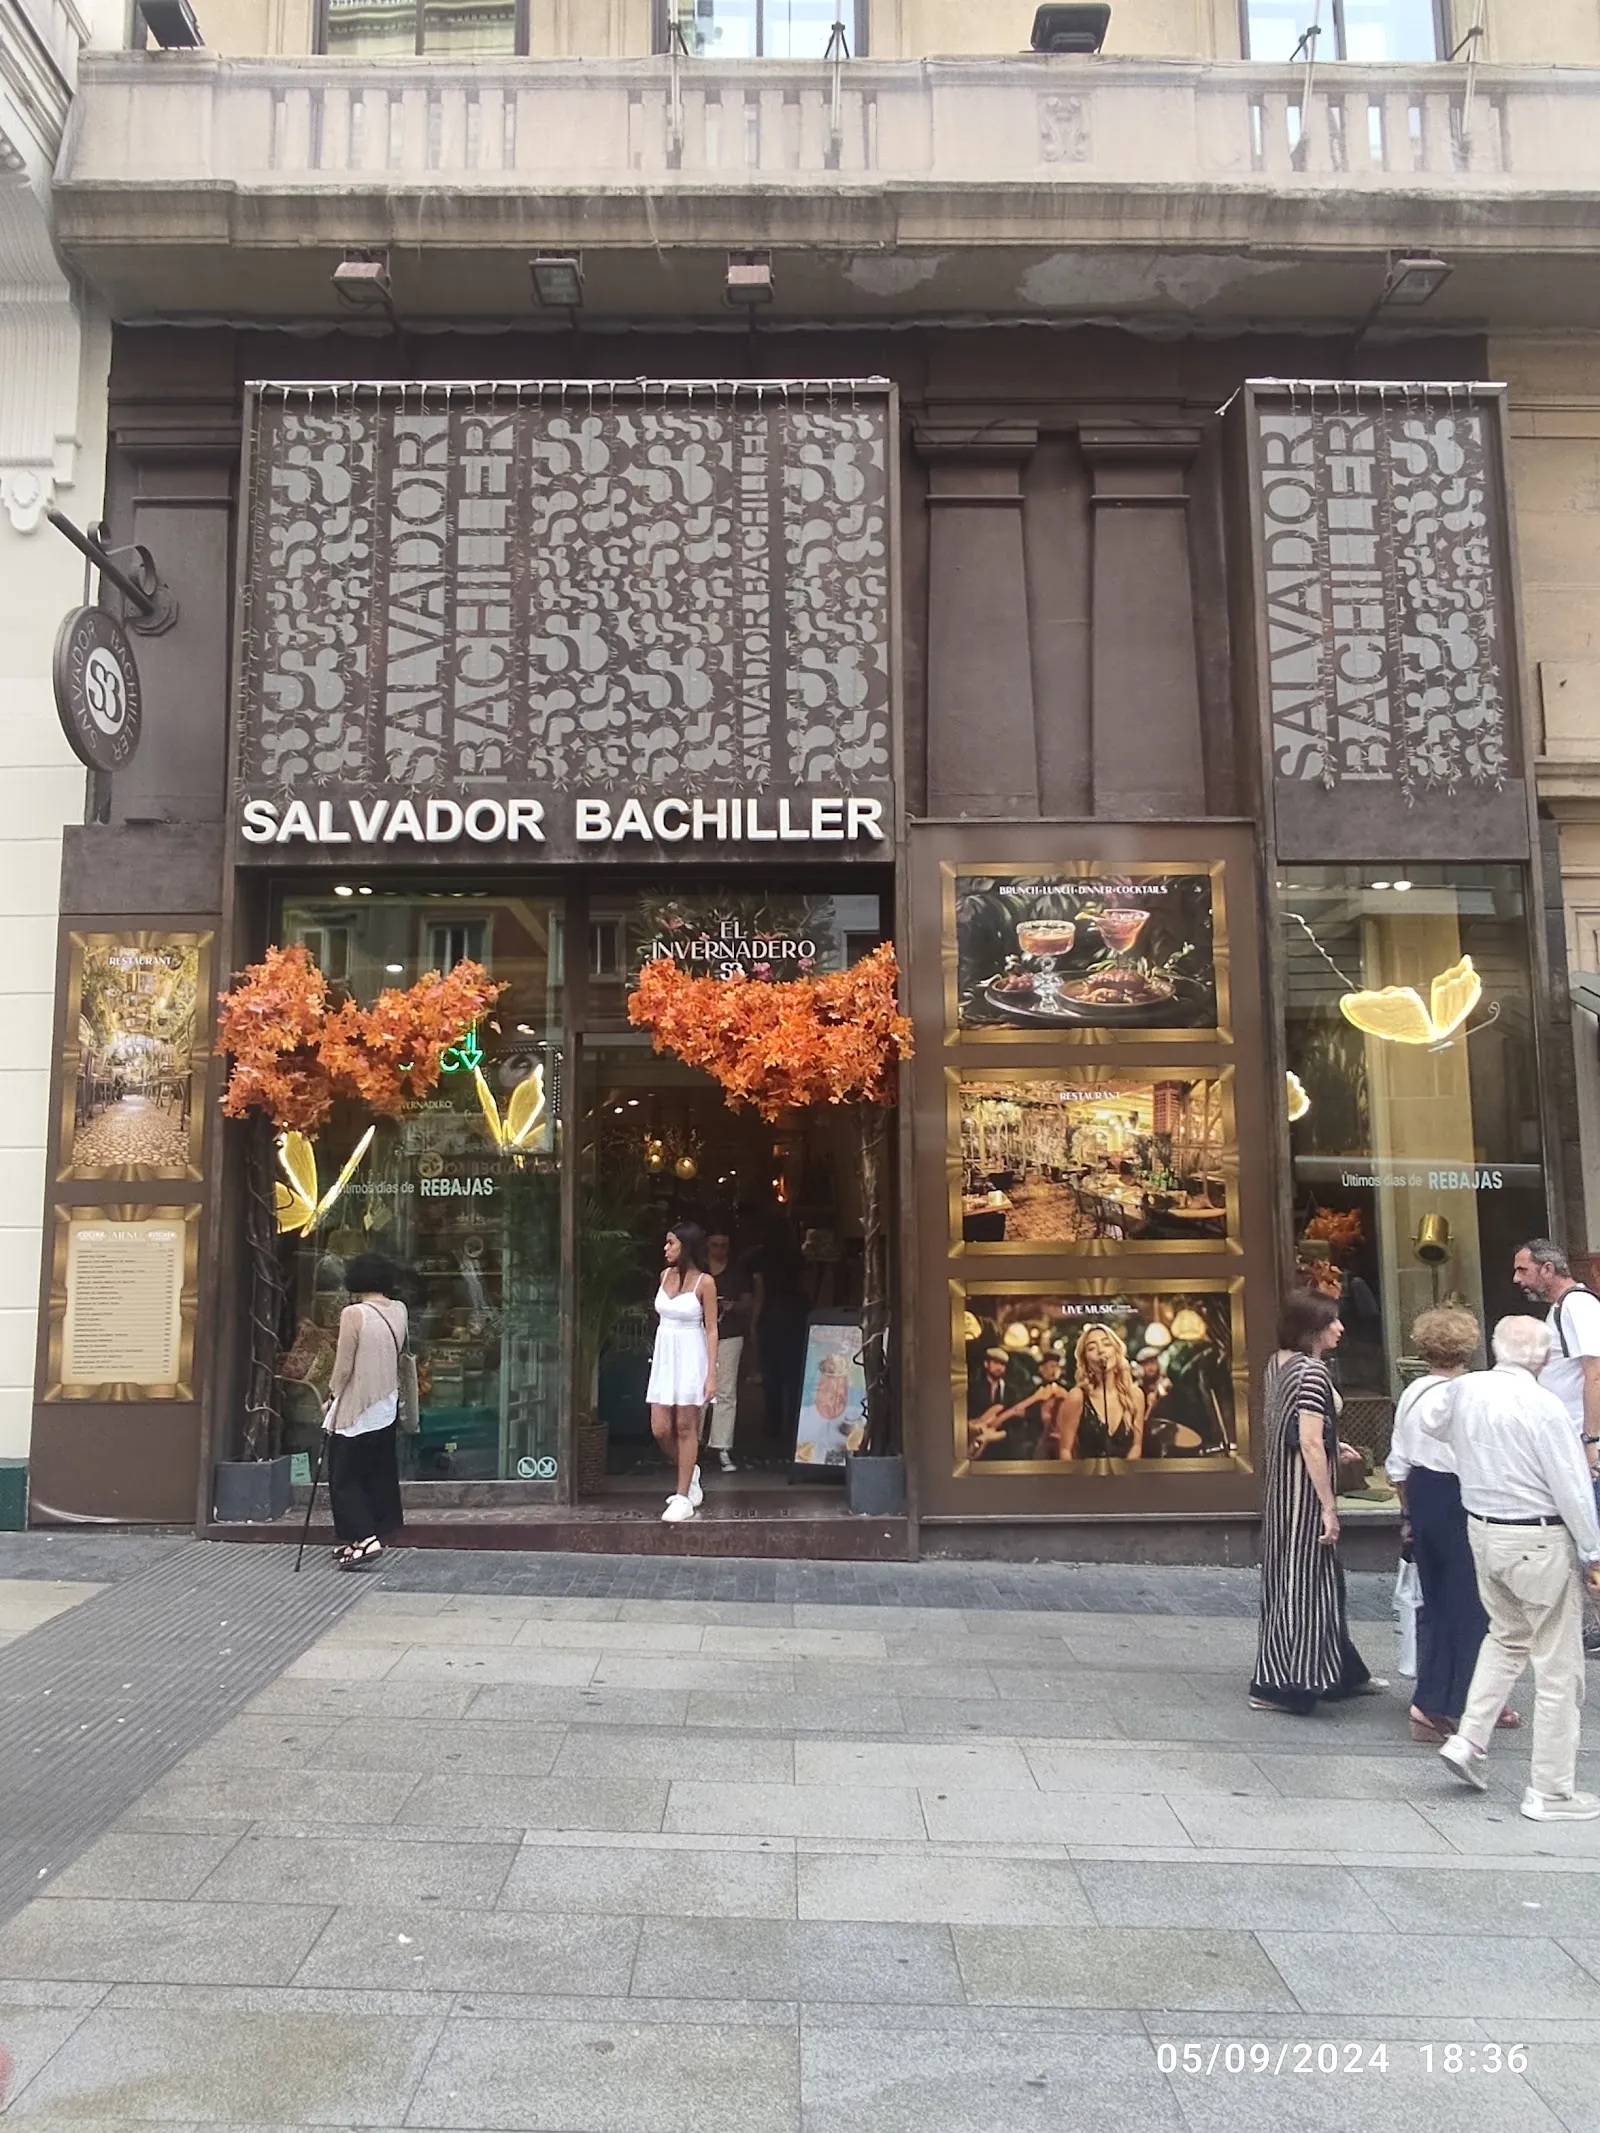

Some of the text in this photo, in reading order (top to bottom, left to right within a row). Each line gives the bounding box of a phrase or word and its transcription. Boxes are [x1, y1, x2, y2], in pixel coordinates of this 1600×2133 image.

[385, 428, 450, 782] SALVADOR
[454, 412, 517, 776] BACHILLER
[1258, 430, 1327, 780] SALVADOR
[1324, 414, 1394, 774] BACHILLER
[72, 621, 97, 748] SALVADOR
[111, 629, 139, 760] BACHILLER
[242, 798, 885, 843] SALVADOR BACHILLER
[720, 920, 748, 939] EL
[109, 956, 171, 966] RESTAURANT
[652, 940, 816, 959] INVERNADERO
[1060, 1091, 1121, 1101] RESTAURANT
[401, 1182, 415, 1194] de
[420, 1178, 494, 1197] REBAJAS
[1341, 1171, 1380, 1187] Últimos
[1408, 1174, 1422, 1186] de
[1428, 1171, 1503, 1190] REBAJAS
[1061, 1304, 1084, 1314] LIVE
[1085, 1304, 1115, 1315] MUSIC
